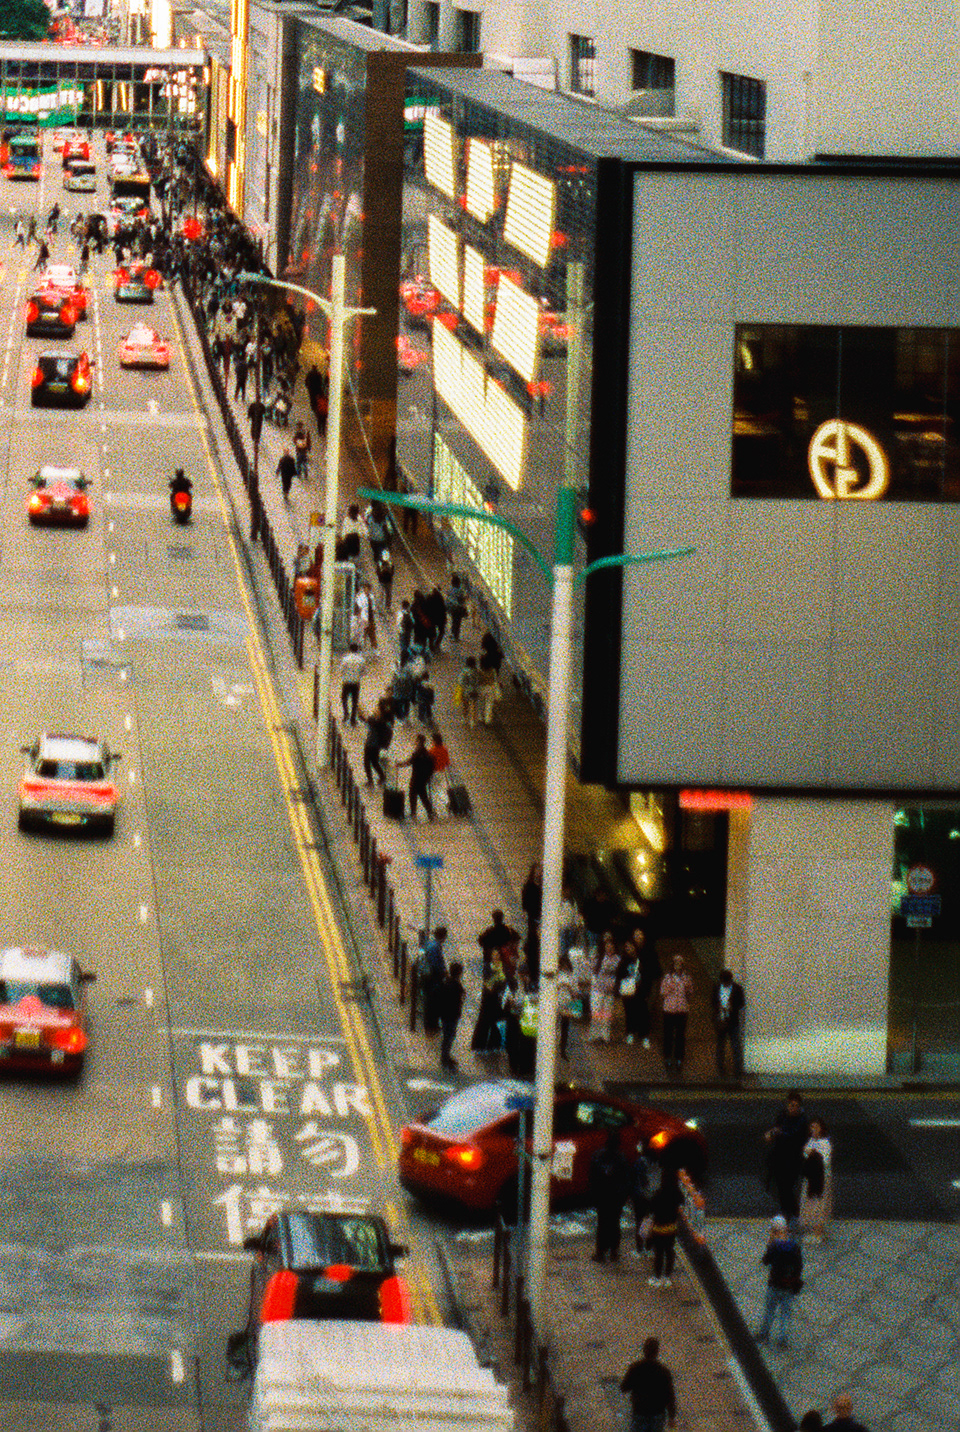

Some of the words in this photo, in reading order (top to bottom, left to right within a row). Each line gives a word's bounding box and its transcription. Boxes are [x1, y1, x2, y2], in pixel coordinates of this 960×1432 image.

[200, 1042, 341, 1079] KEEP
[186, 1076, 373, 1118] CLEAR
[214, 1118, 360, 1177] 請勿
